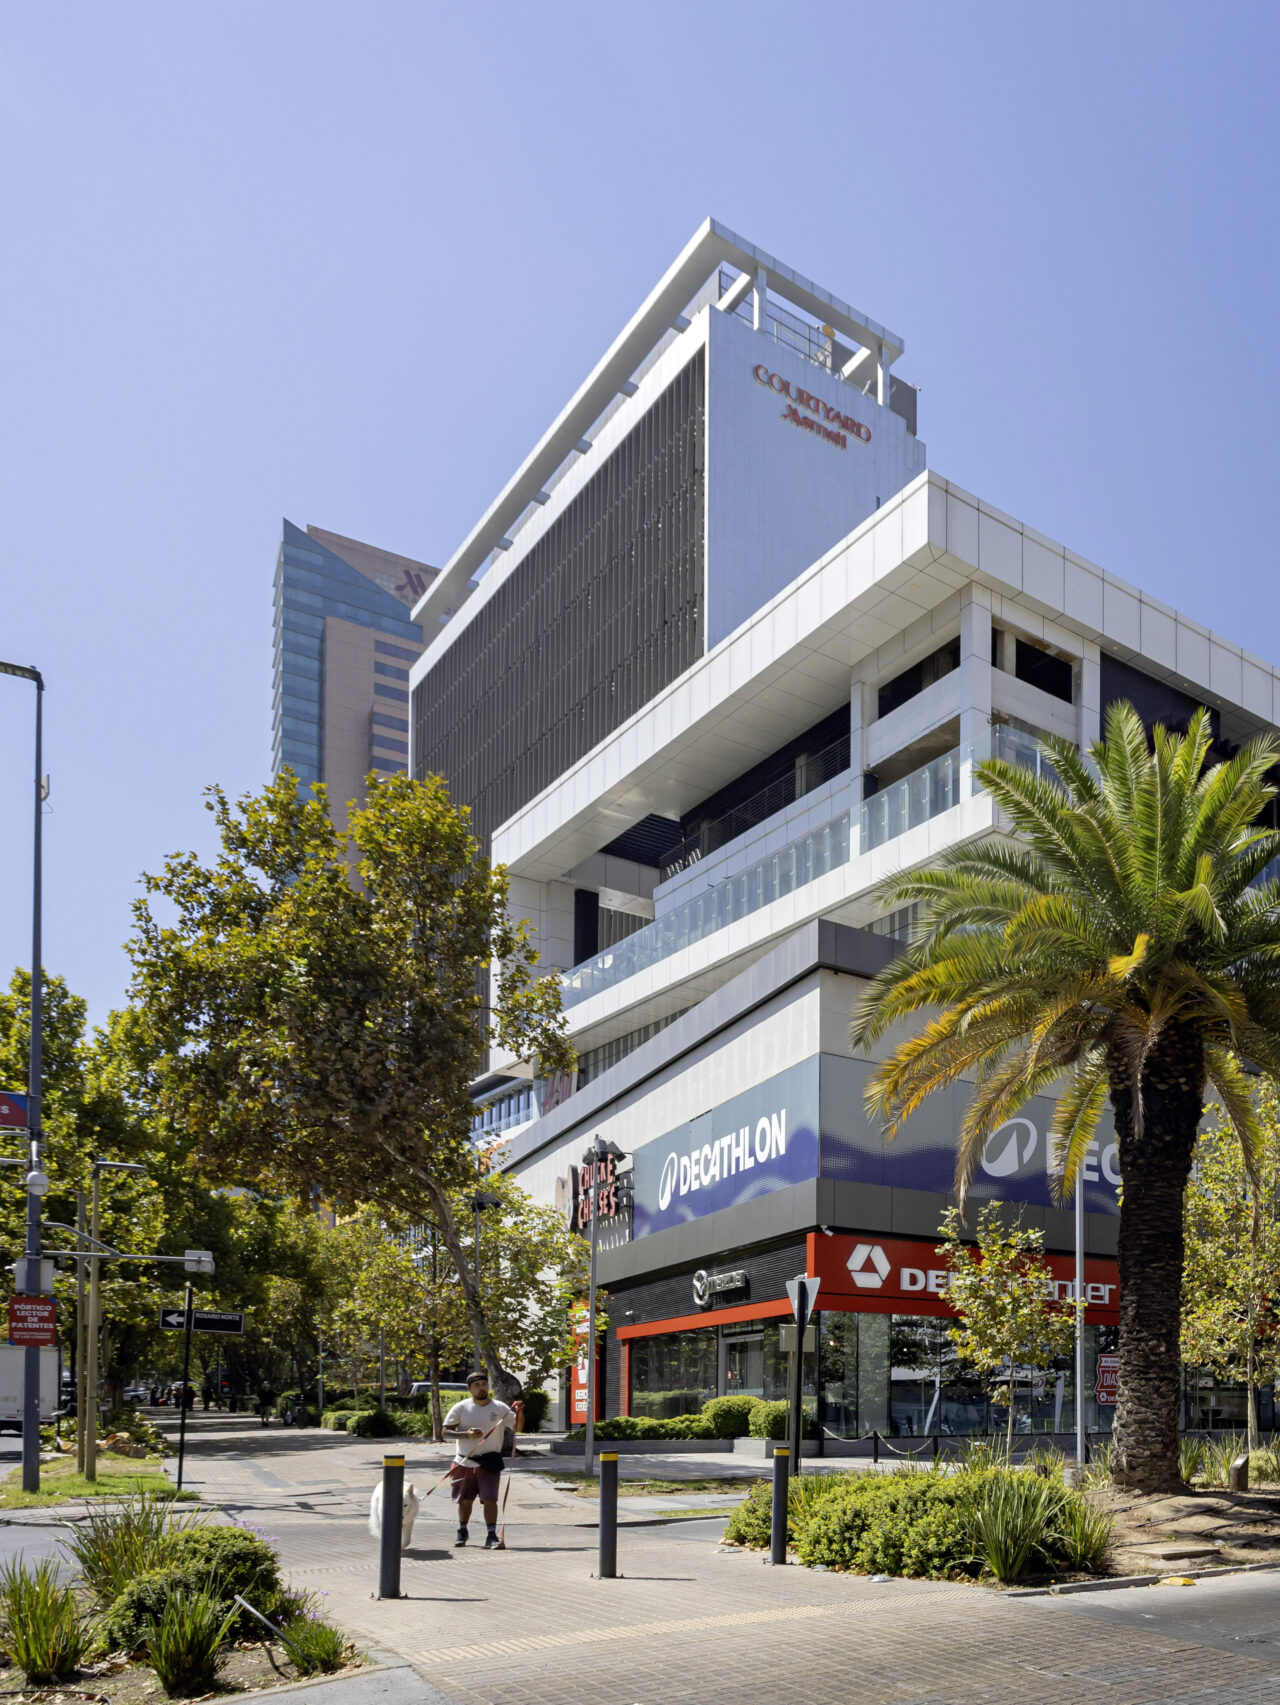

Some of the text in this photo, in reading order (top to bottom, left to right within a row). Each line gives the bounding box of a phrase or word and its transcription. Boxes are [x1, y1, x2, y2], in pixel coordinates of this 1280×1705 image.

[753, 364, 872, 443] COURTYARD
[781, 404, 847, 450] Marriott
[679, 1108, 787, 1196] DECATHLON
[14, 1303, 52, 1311] PÓRTICO
